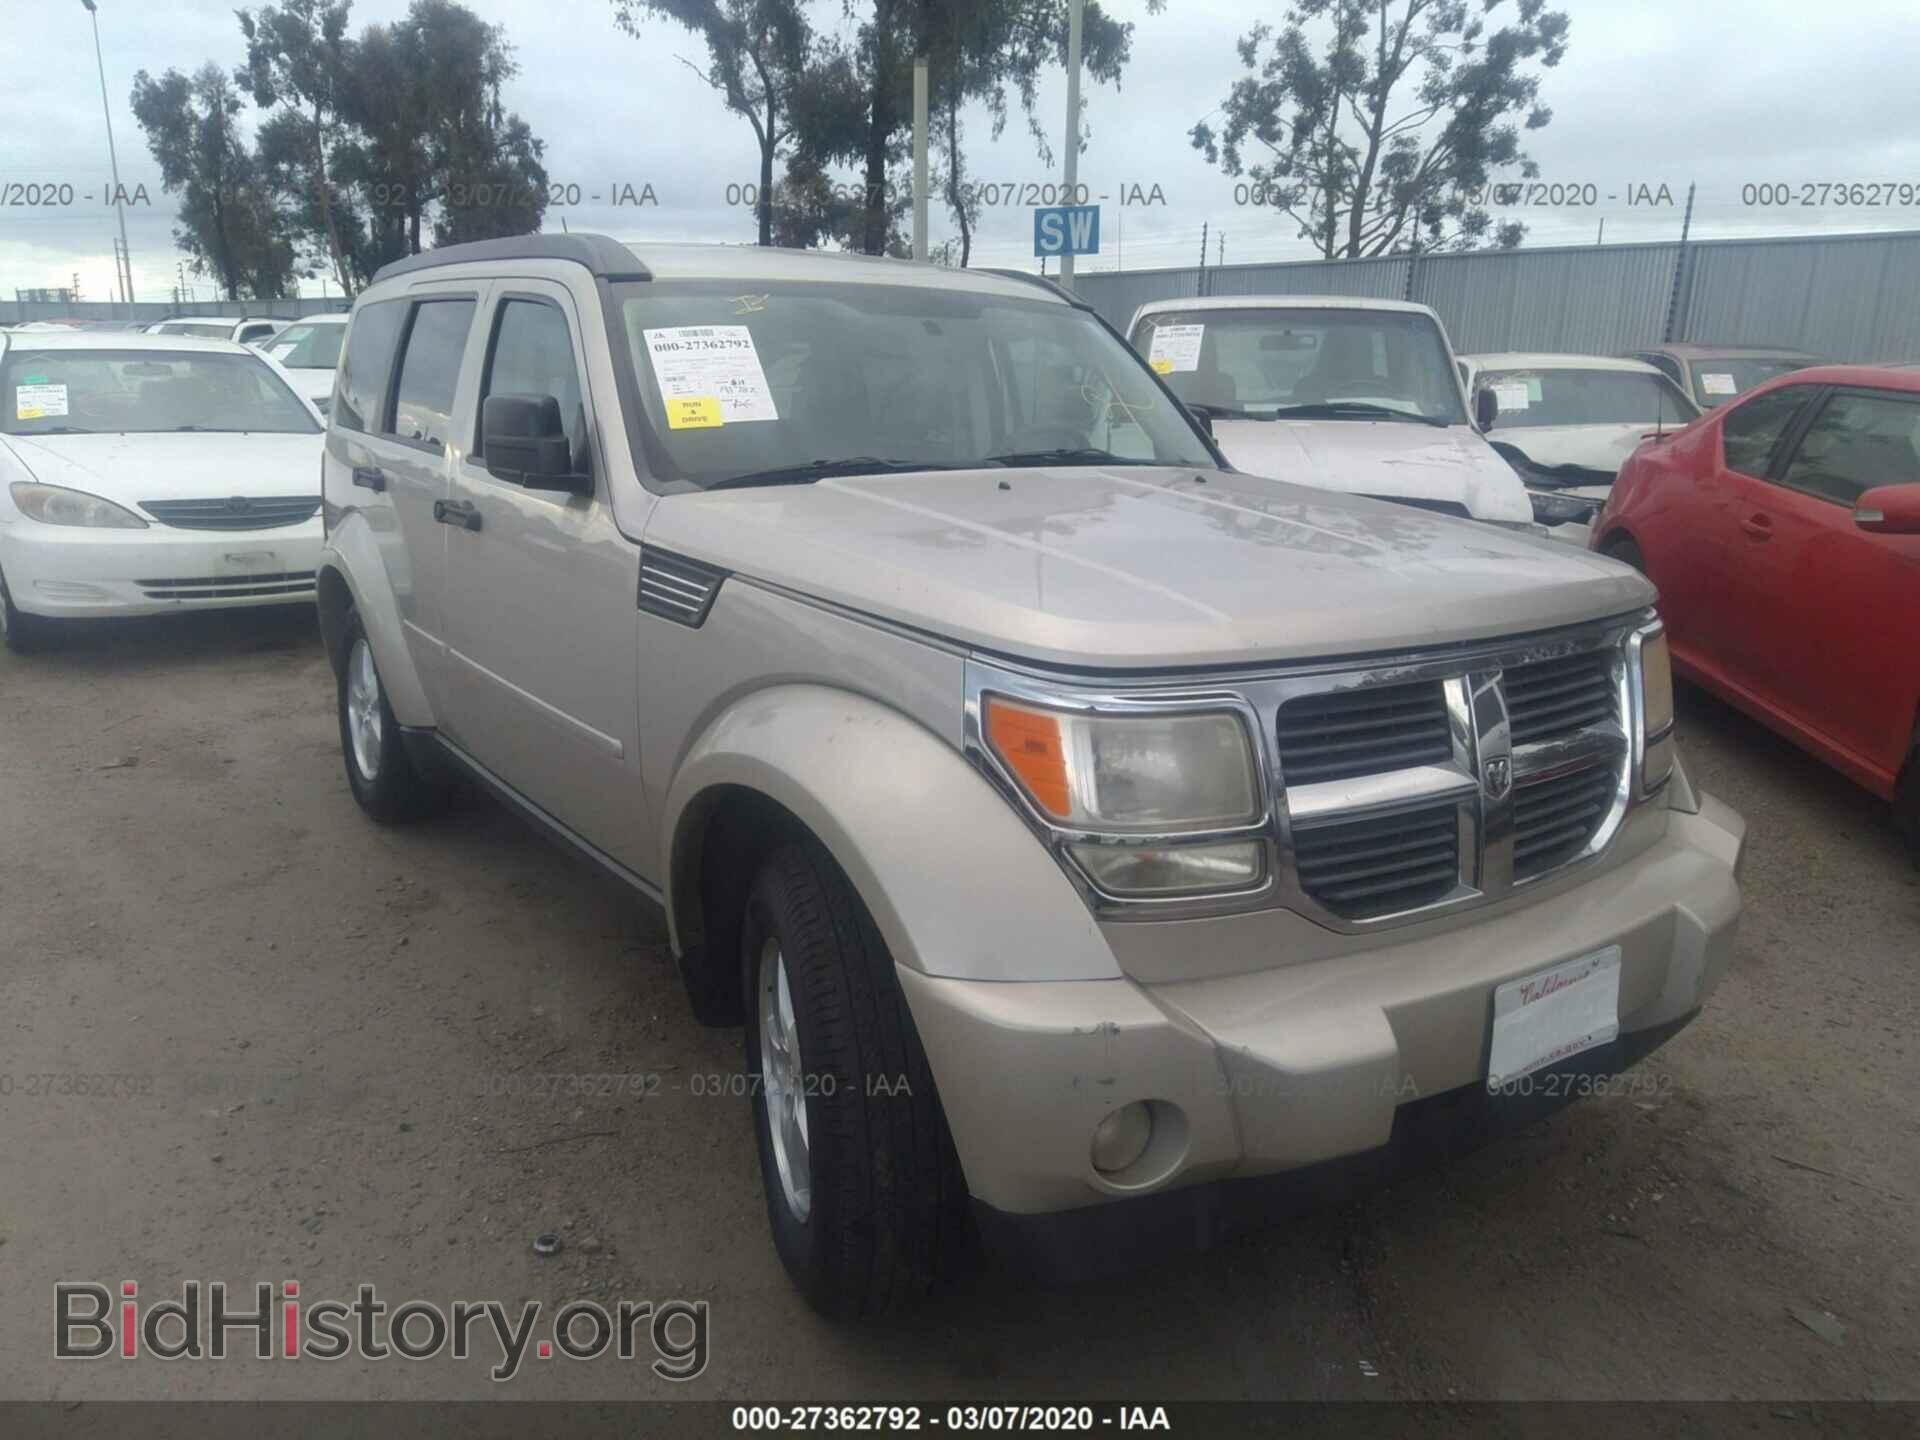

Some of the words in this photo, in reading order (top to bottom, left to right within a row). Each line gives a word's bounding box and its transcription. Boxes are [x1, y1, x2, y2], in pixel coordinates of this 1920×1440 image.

[1040, 211, 1093, 252] SW
[653, 338, 751, 353] 000-27362792
[682, 401, 702, 409] RUN
